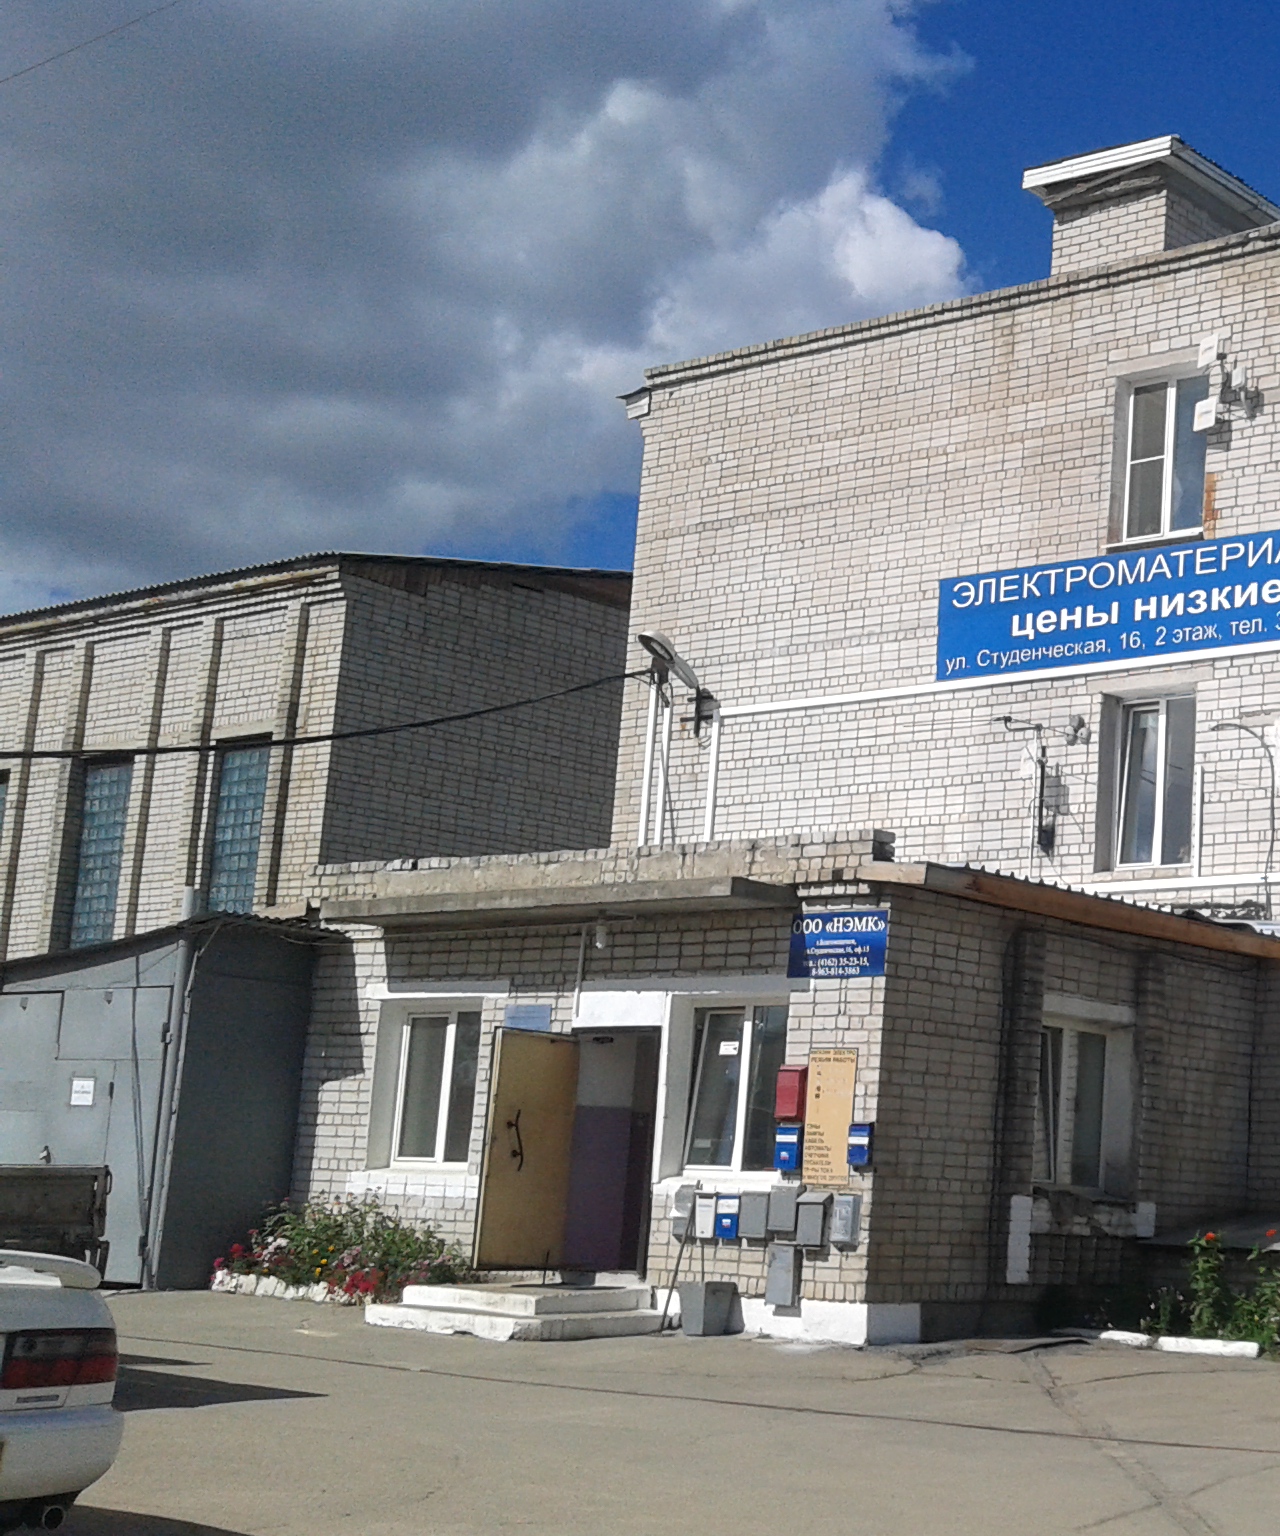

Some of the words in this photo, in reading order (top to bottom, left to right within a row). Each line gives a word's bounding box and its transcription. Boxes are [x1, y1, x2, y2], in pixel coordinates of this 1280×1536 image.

[1011, 600, 1118, 641] цены
[945, 654, 970, 676] ул.
[977, 638, 1111, 669] Студенческая,
[1120, 631, 1146, 652] 16,
[1155, 627, 1166, 646] 2
[1172, 622, 1221, 645] этаж,
[1230, 616, 1267, 637] тел.
[793, 918, 822, 934] ООО
[825, 916, 885, 933] «НЭМК»
